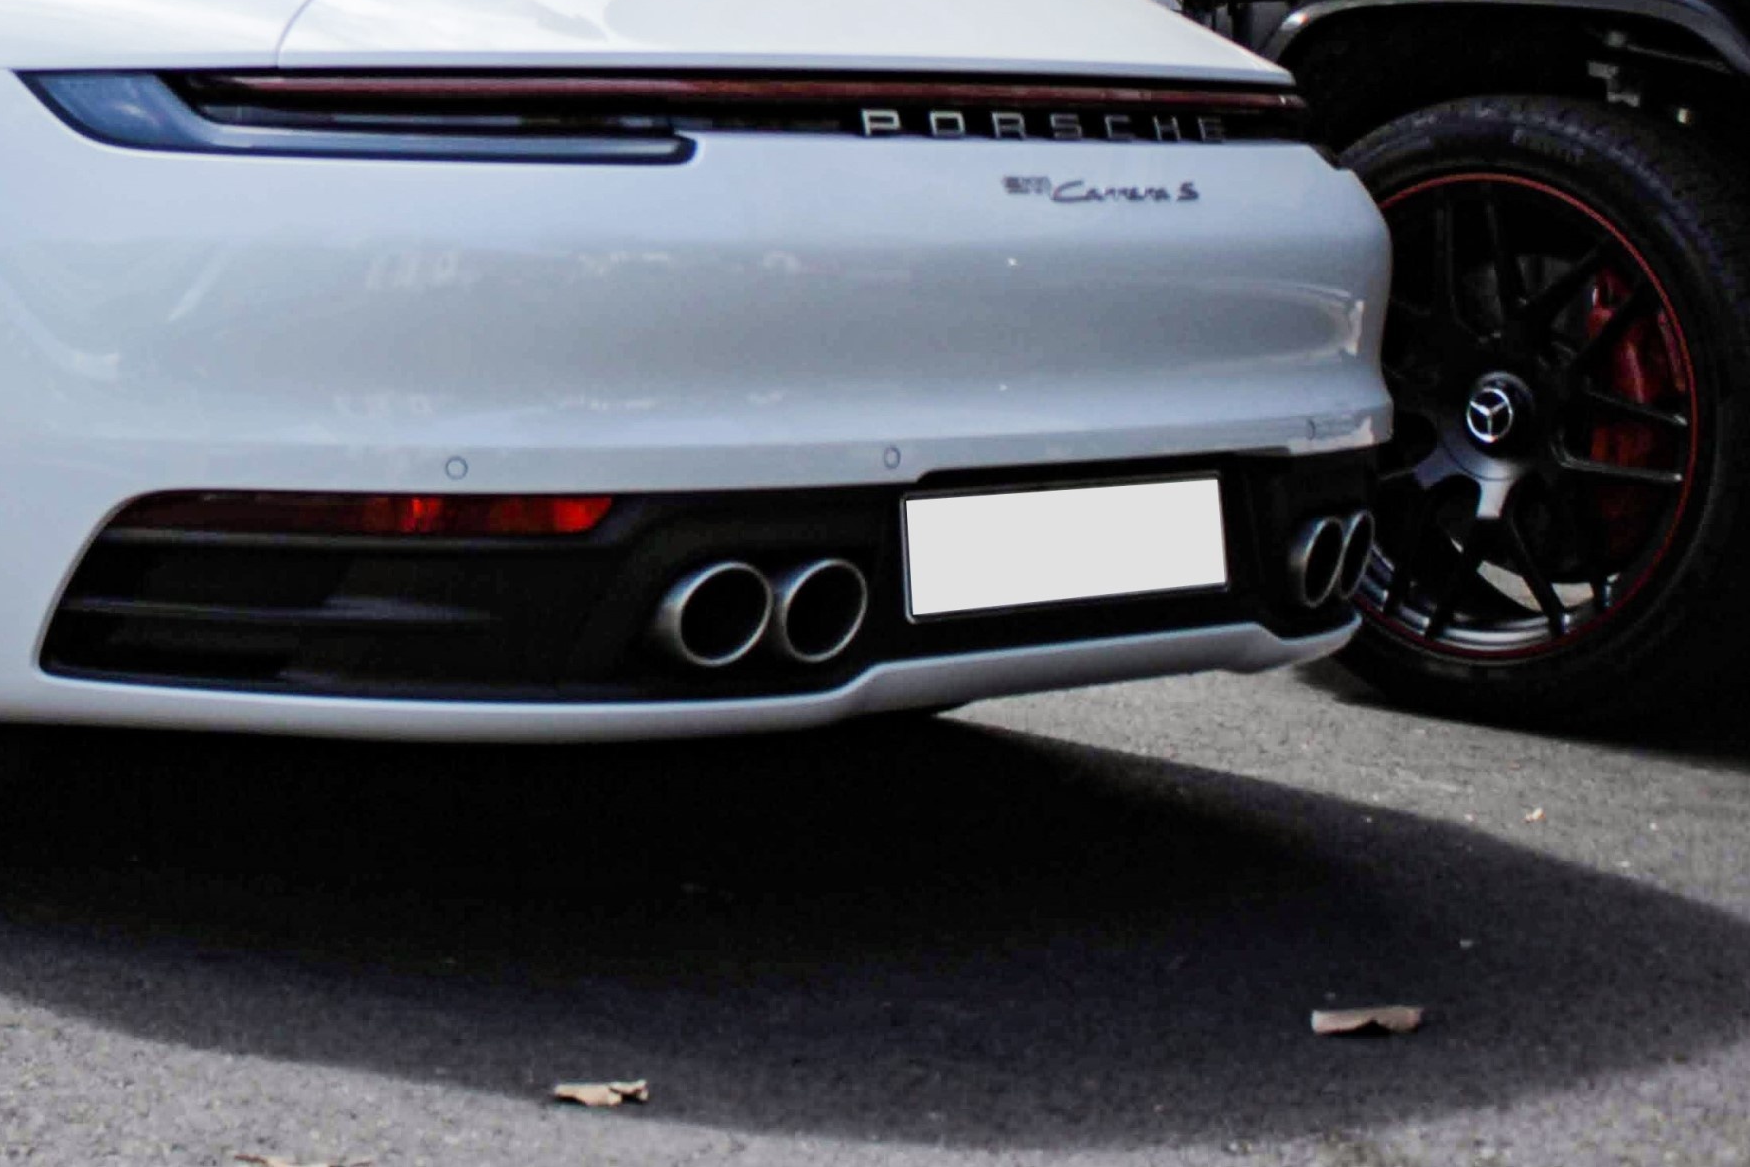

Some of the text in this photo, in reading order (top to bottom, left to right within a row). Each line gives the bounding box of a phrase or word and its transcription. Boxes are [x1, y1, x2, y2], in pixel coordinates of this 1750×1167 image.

[861, 108, 1225, 144] PORSCHE
[1051, 179, 1171, 203] Carrera
[1176, 181, 1200, 202] S
